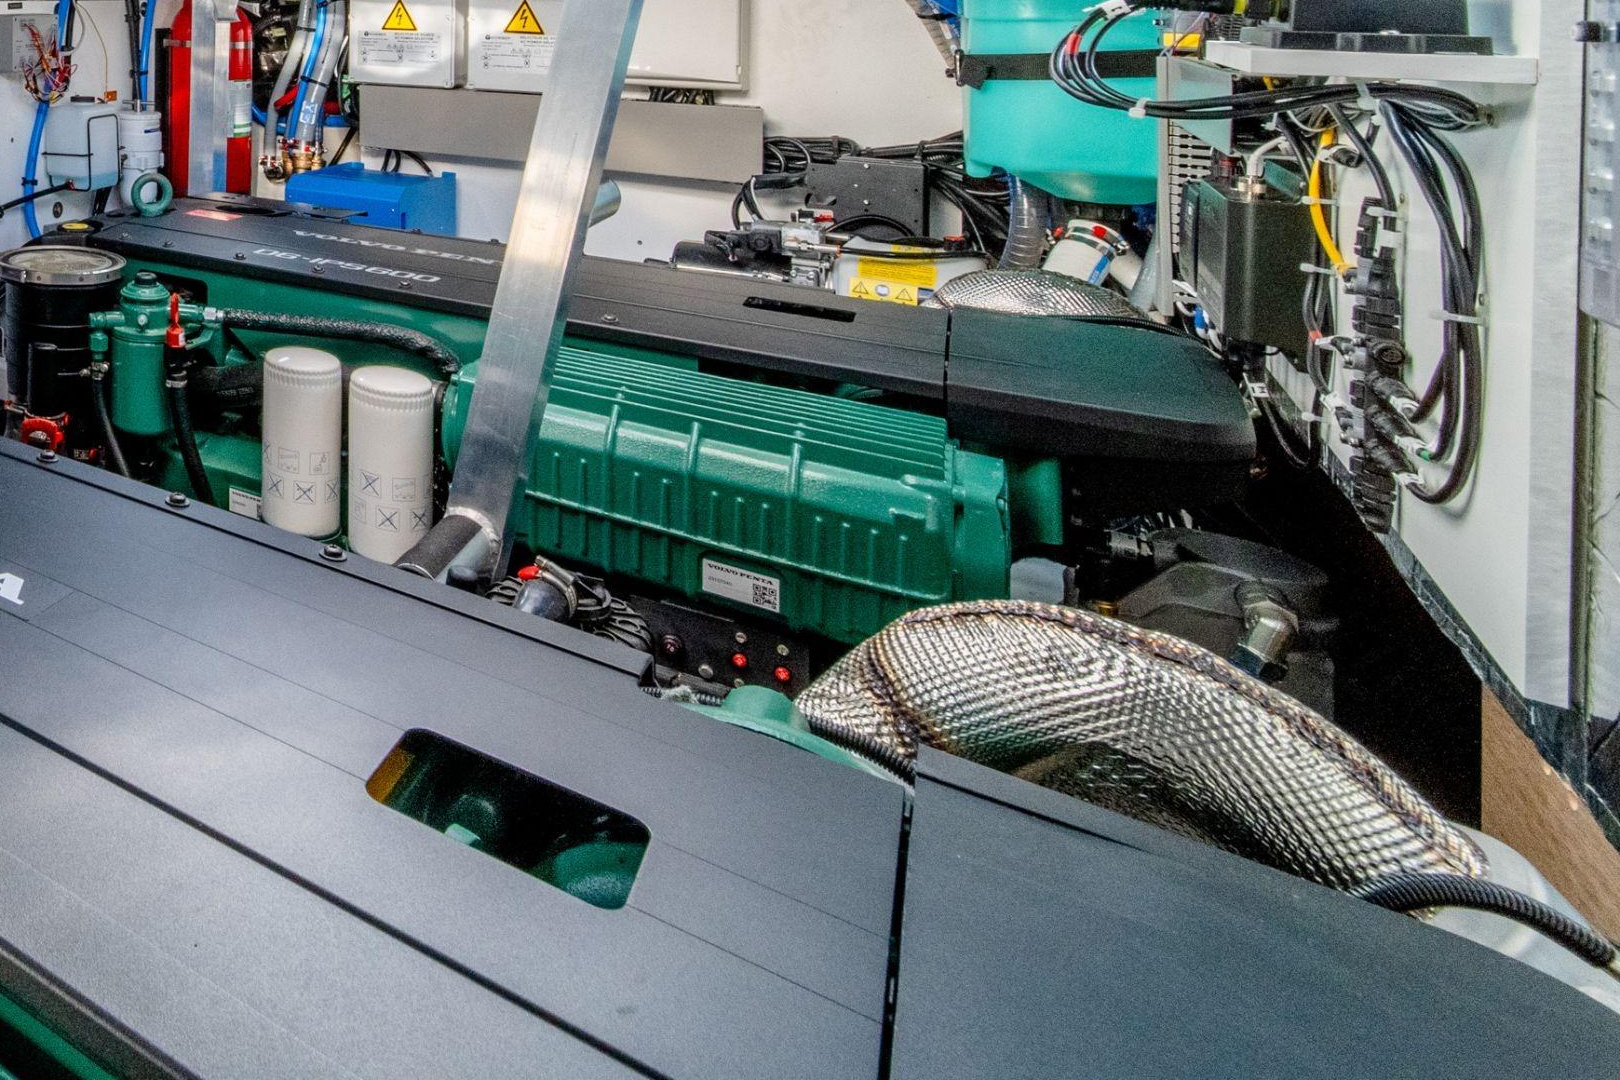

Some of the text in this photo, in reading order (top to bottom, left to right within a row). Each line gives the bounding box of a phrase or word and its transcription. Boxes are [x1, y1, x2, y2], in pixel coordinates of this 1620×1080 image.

[293, 229, 503, 265] VOLVO PEN
[253, 248, 442, 283] D6-IPS600
[707, 563, 738, 576] VOLVO
[739, 572, 774, 586] PENTA
